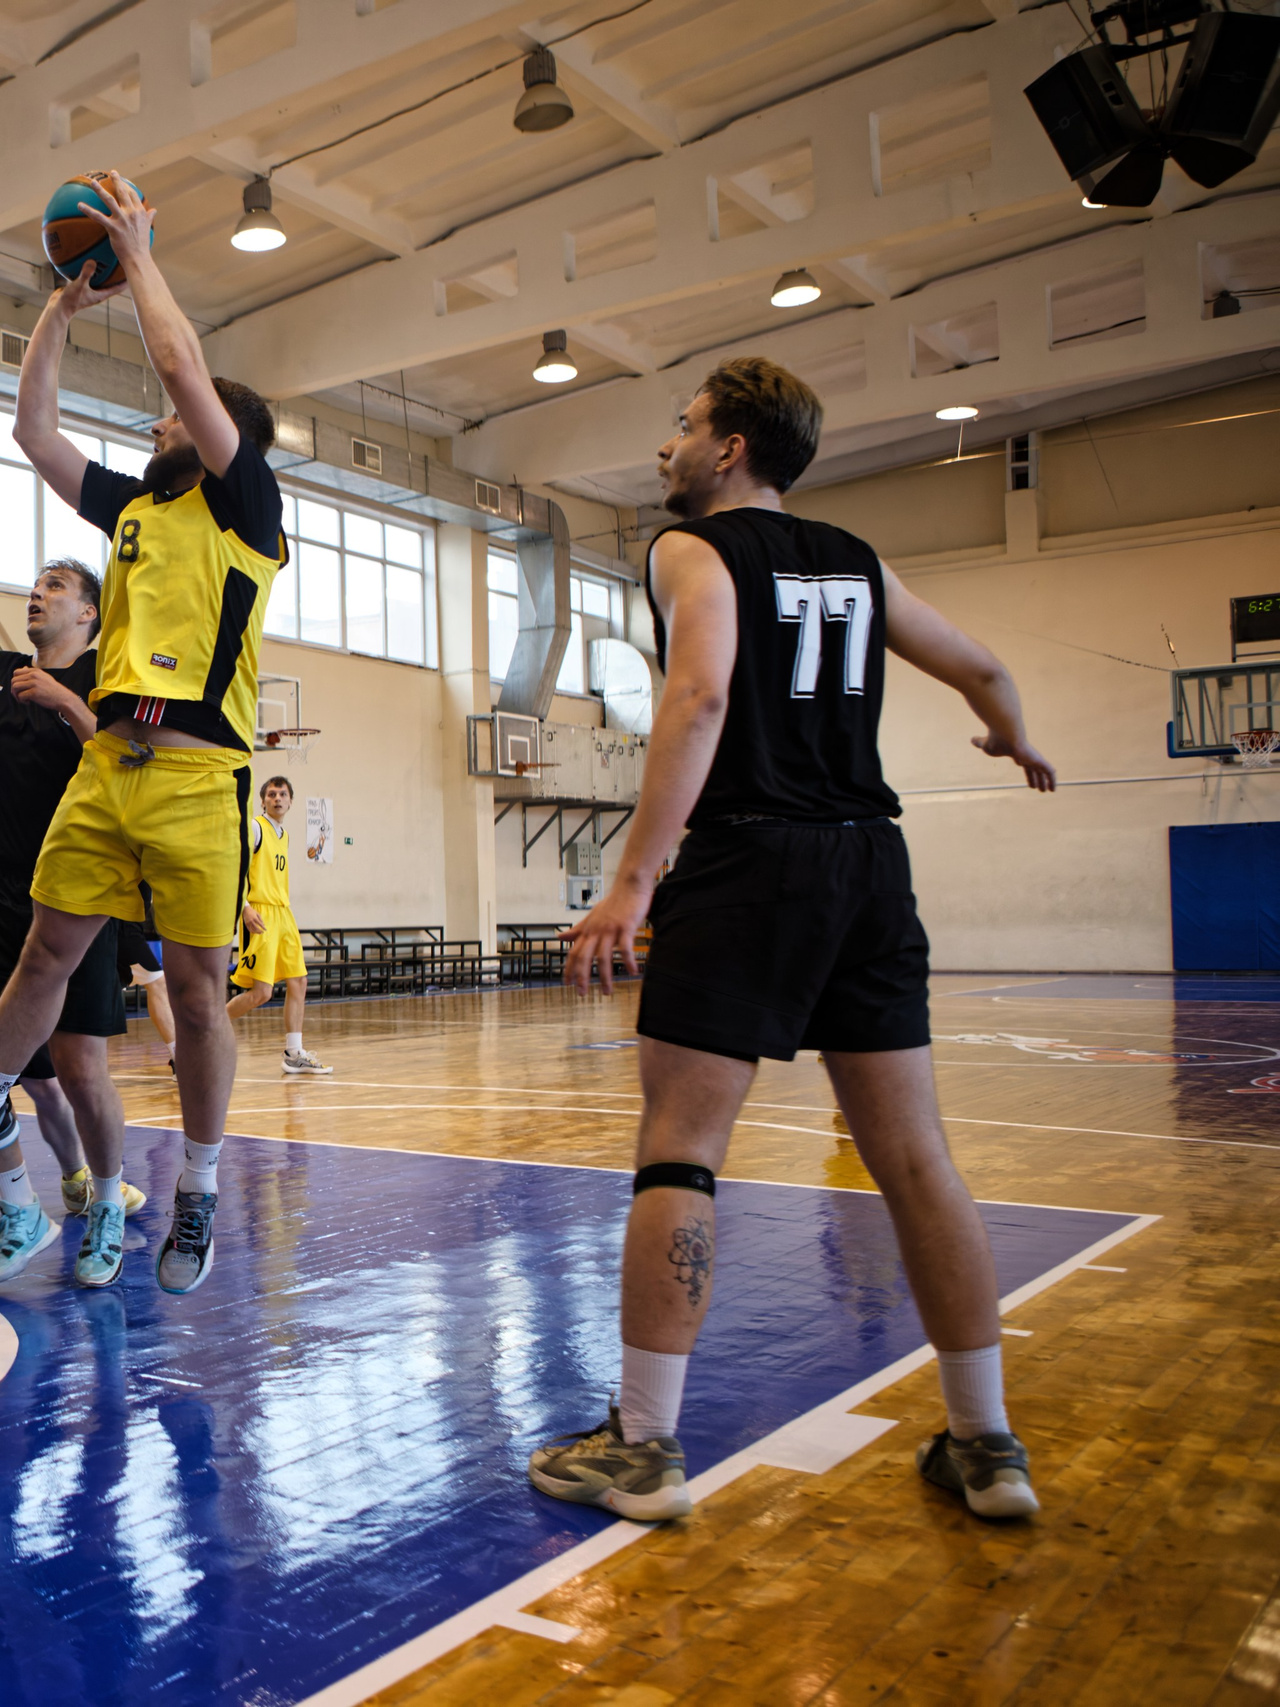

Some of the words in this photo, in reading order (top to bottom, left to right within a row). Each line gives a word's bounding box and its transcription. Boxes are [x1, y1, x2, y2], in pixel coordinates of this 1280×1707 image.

[117, 519, 141, 563] 8
[772, 572, 874, 699] 77
[275, 853, 286, 872] 10
[241, 953, 257, 970] 10
